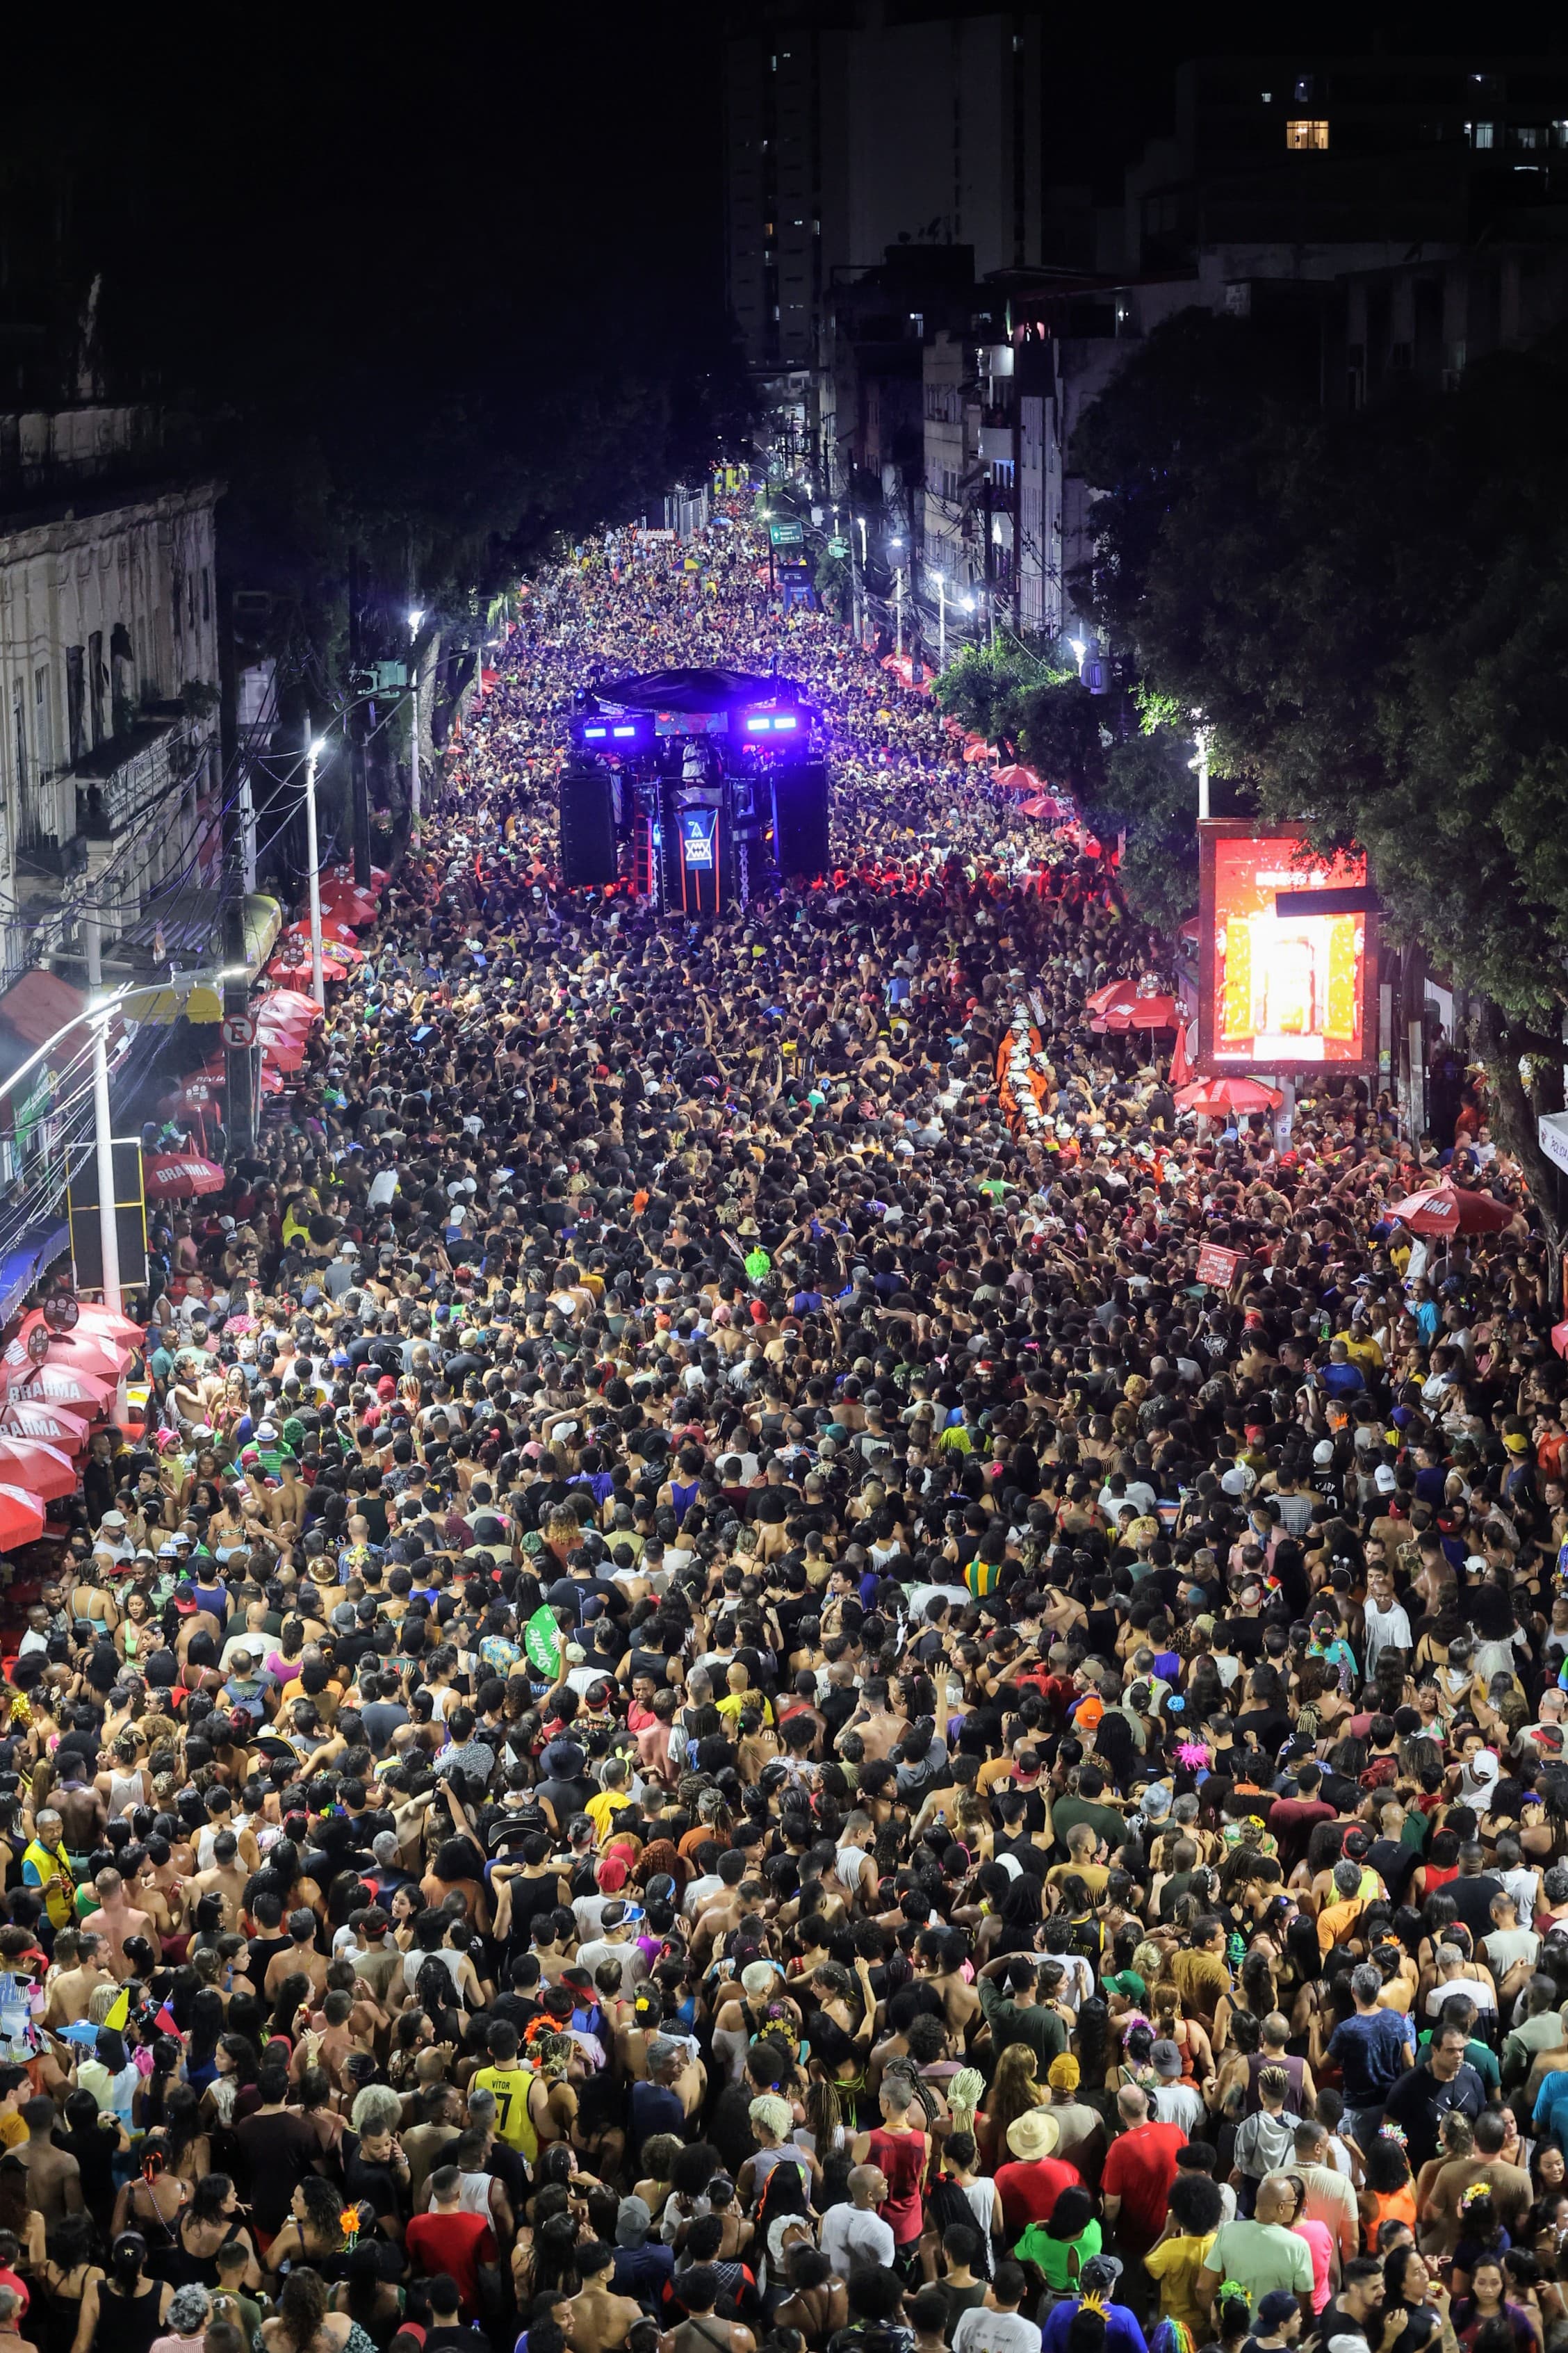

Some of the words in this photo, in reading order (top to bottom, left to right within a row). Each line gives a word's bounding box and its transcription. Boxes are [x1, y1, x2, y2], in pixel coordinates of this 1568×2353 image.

[231, 1022, 245, 1043] E
[156, 1164, 211, 1183] BRAHMA
[9, 1382, 81, 1402] BRAHMA
[0, 1419, 62, 1437] RAHMA
[529, 1629, 553, 1669] Sprite
[495, 2092, 513, 2131] 7
